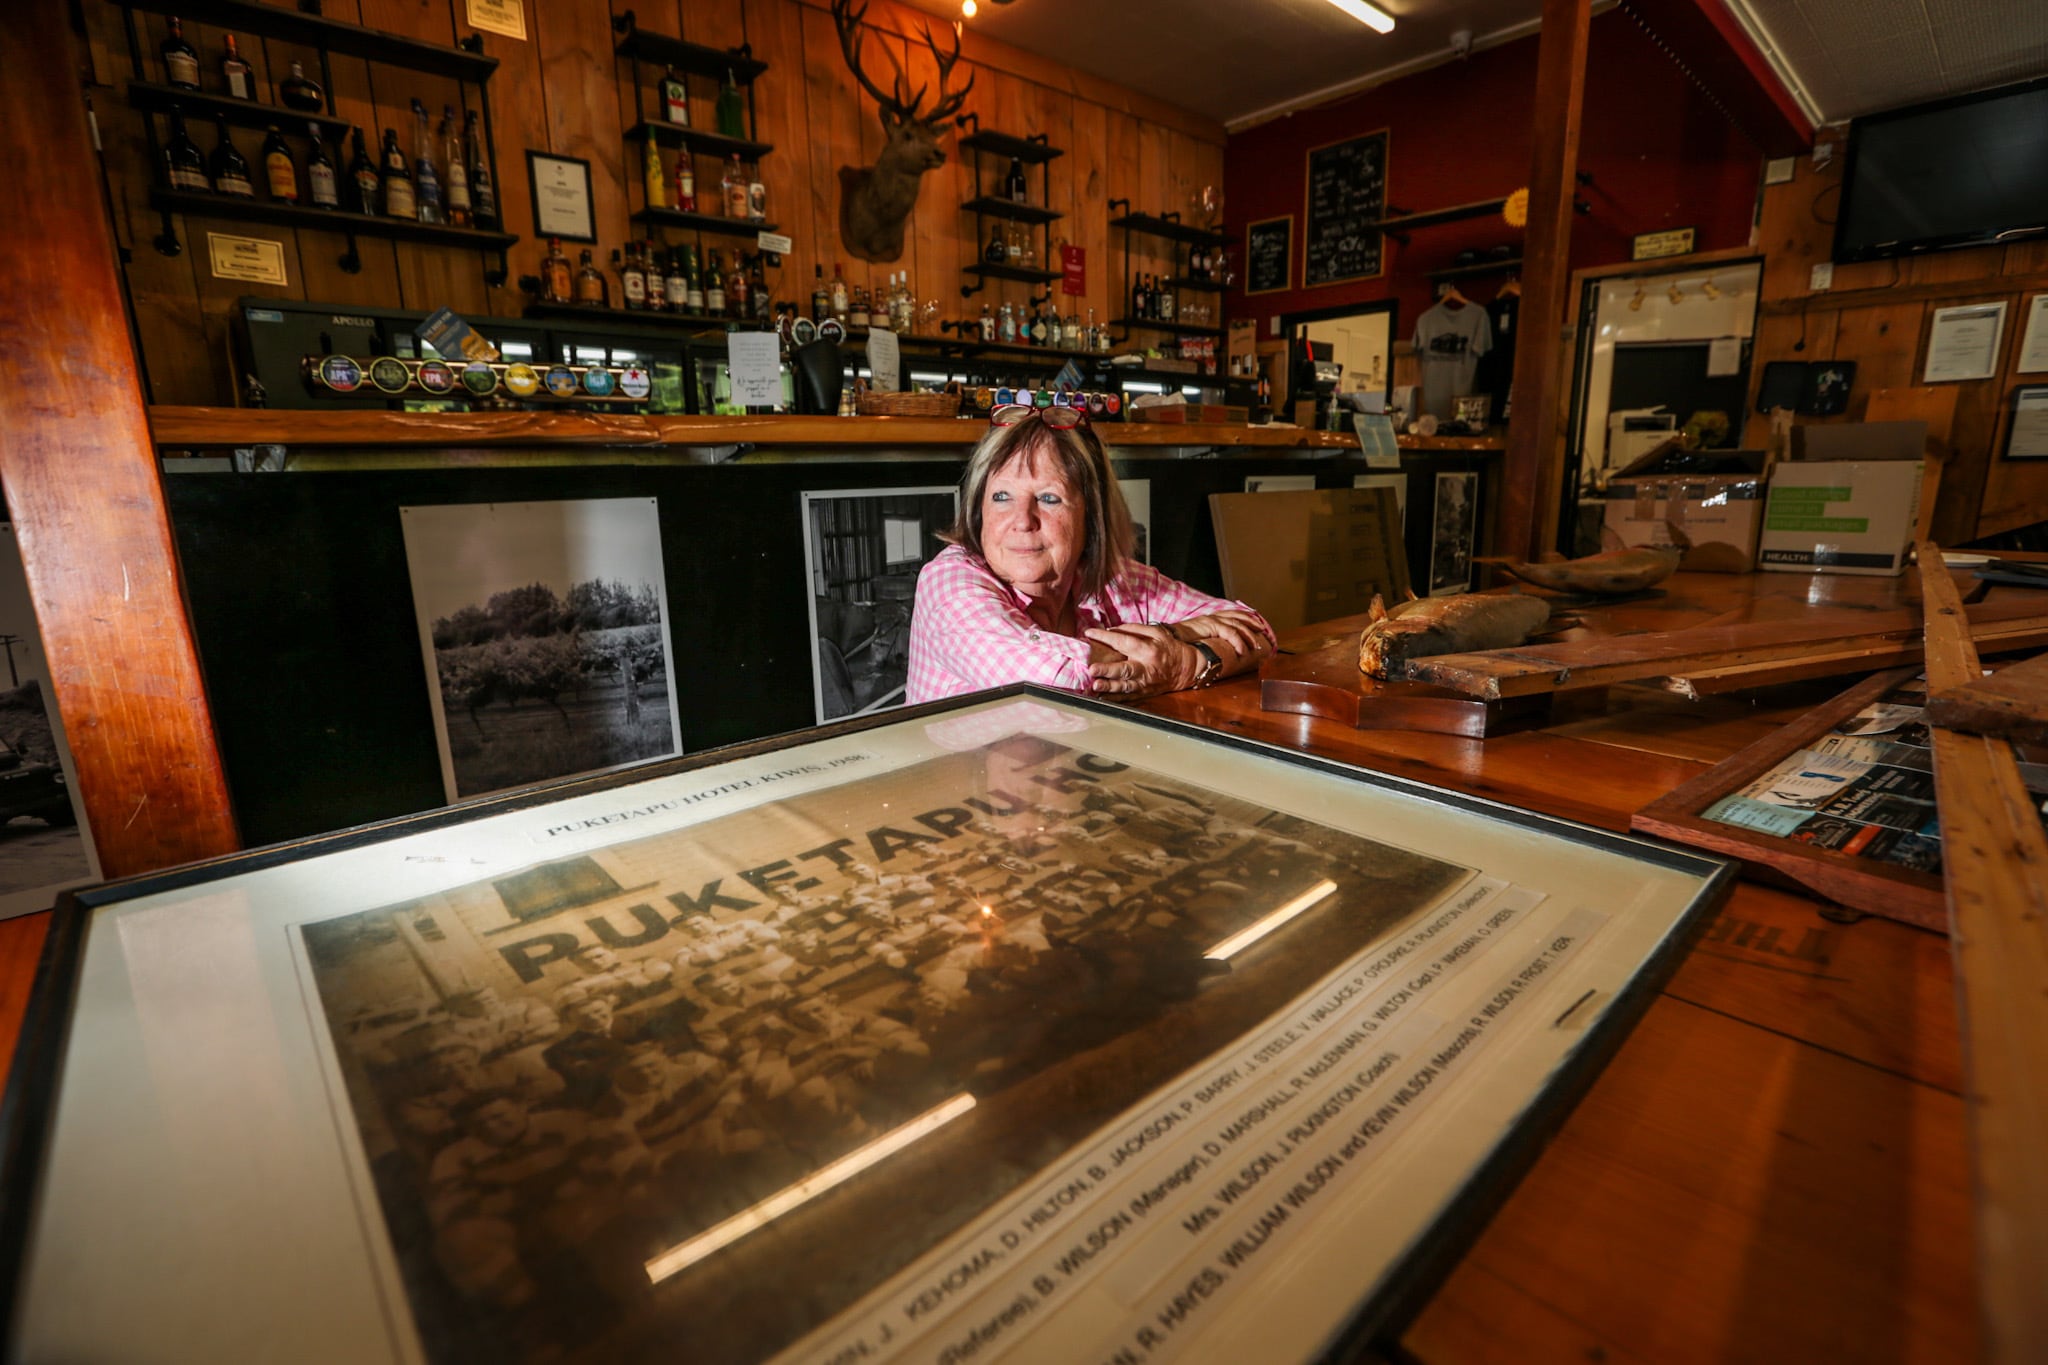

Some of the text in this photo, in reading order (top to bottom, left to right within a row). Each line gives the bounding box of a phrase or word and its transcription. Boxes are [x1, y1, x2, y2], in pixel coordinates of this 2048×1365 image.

[331, 315, 375, 327] APOLLO
[1766, 552, 1809, 562] HEALTH
[546, 800, 680, 837] PUKETAPU
[682, 778, 760, 805] HOTEL
[498, 788, 1027, 984] PUKETAPU
[1216, 1203, 1292, 1269] WILLIAM
[1281, 1154, 1346, 1209] WILSON
[1339, 1132, 1368, 1162] and
[1357, 1102, 1401, 1140] KEVIN
[1391, 1063, 1440, 1108] WILSON
[1054, 1210, 1134, 1278] WILSON
